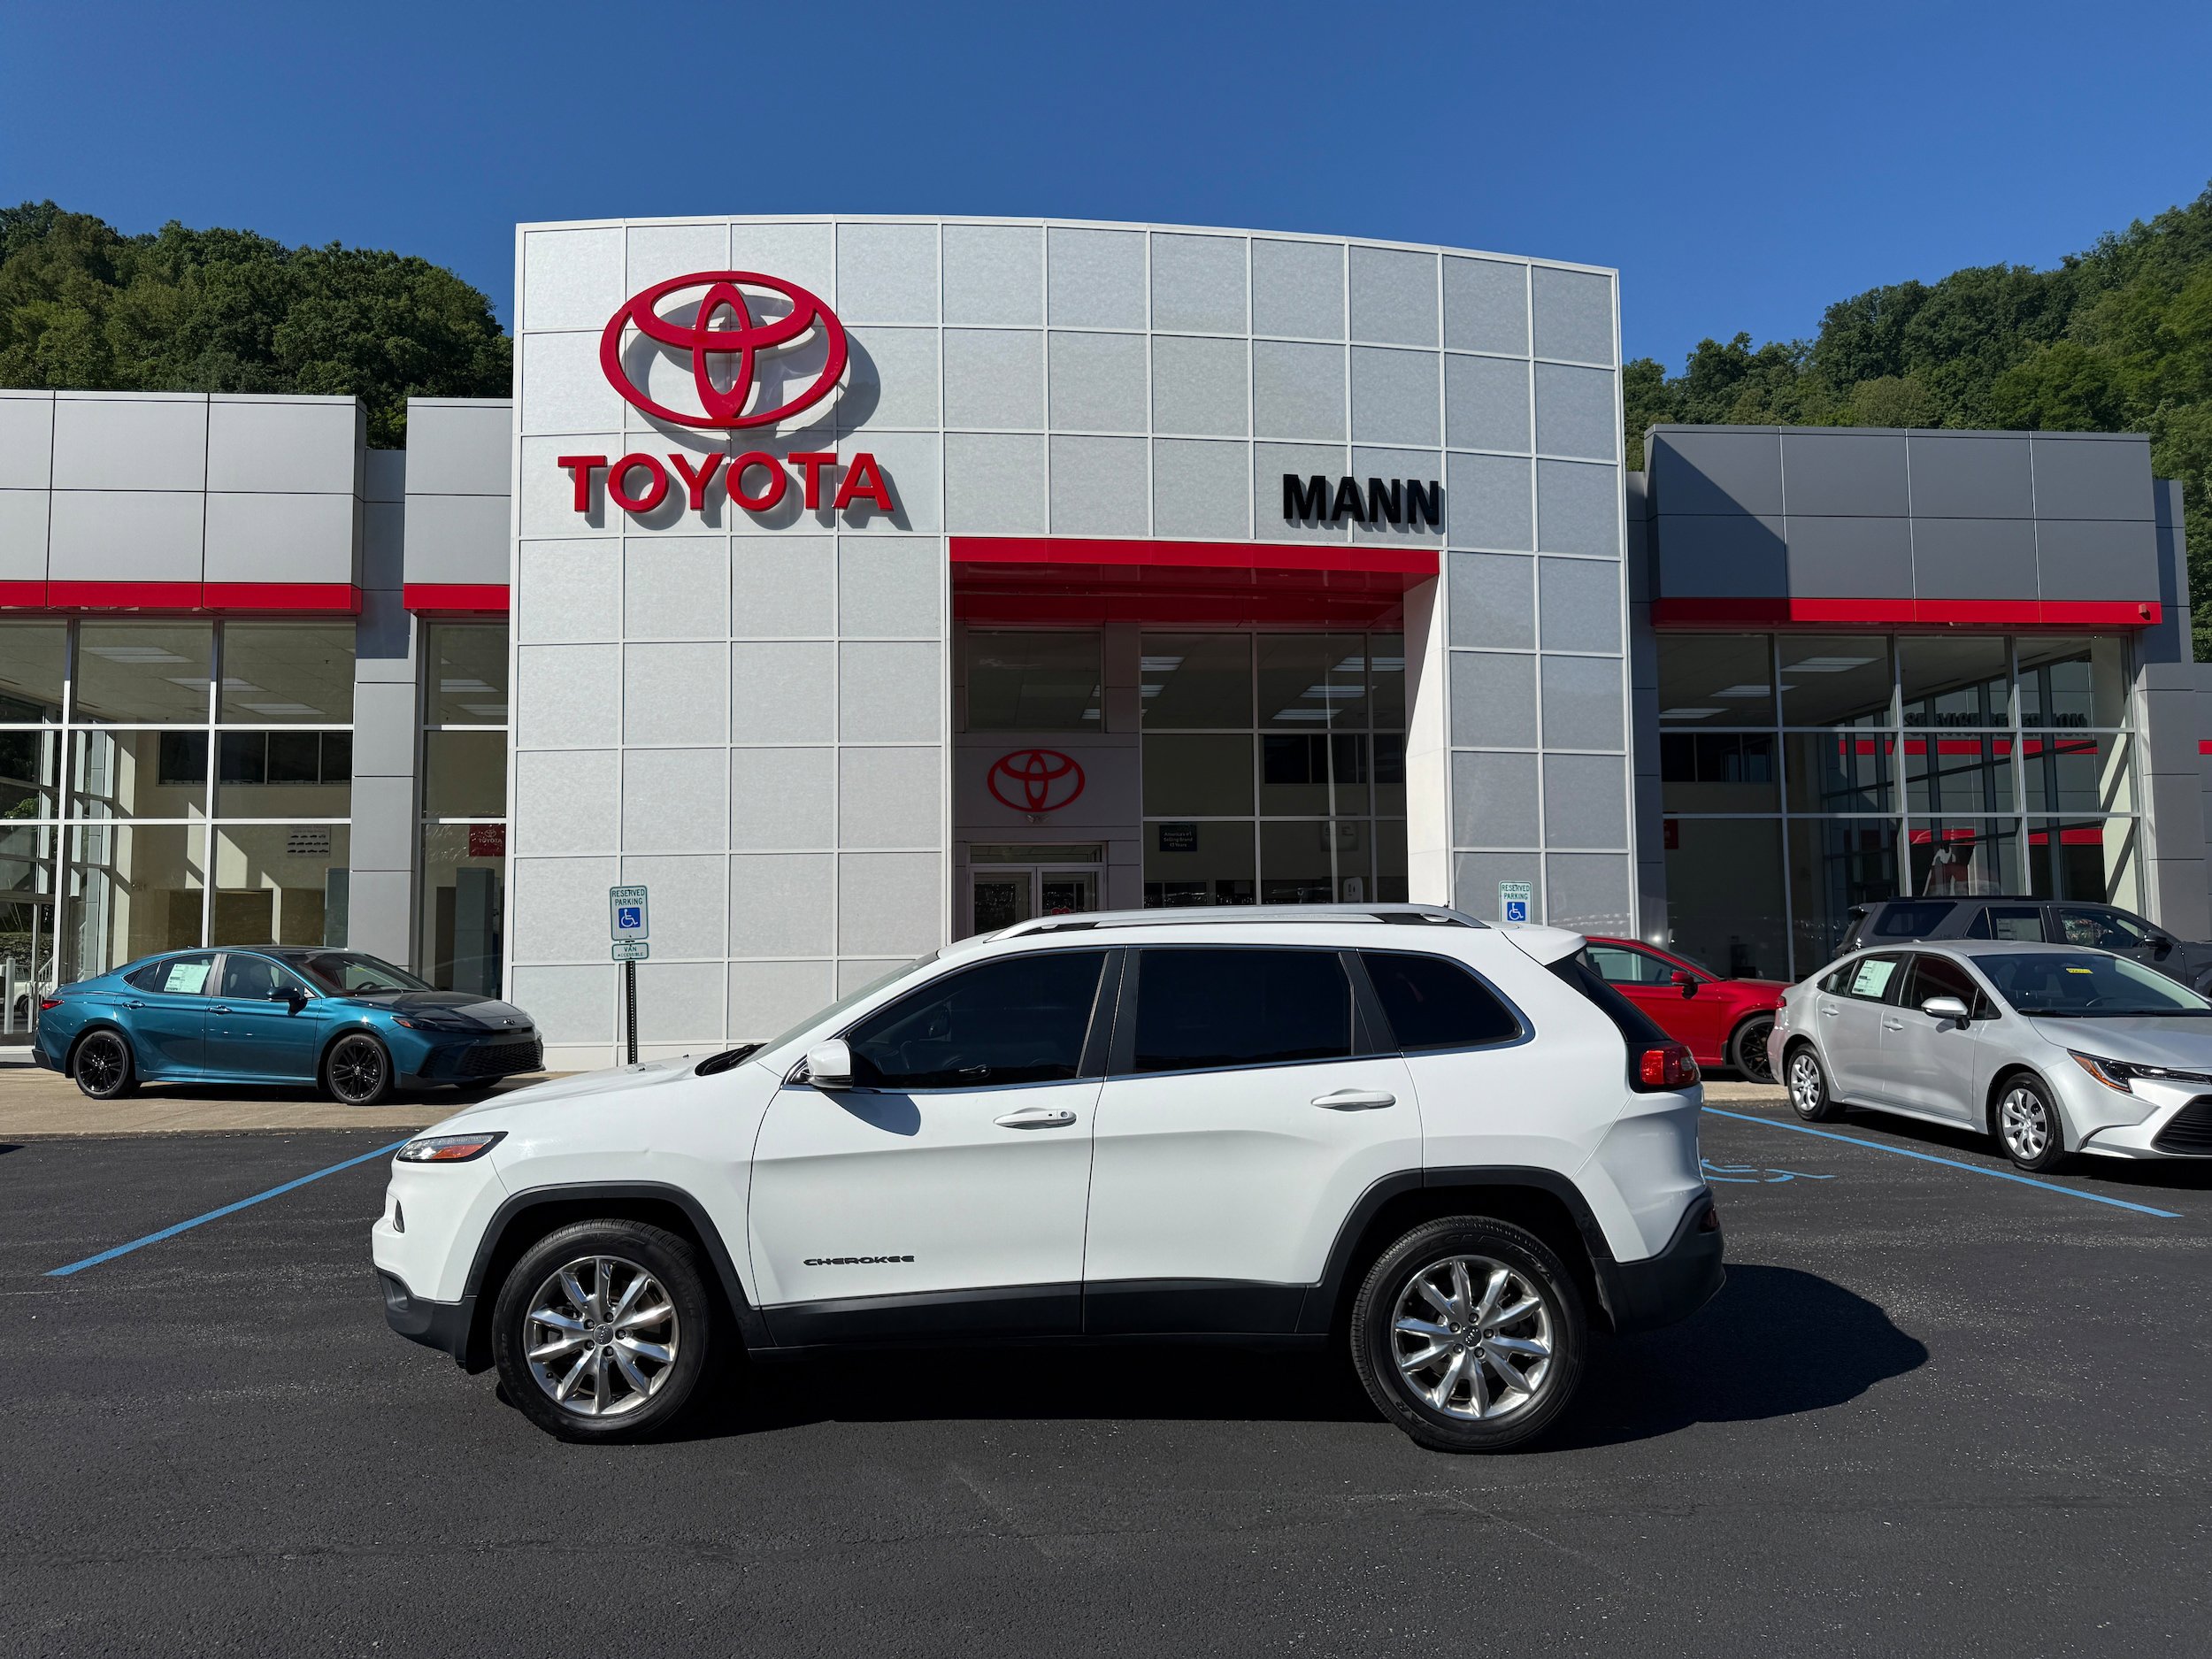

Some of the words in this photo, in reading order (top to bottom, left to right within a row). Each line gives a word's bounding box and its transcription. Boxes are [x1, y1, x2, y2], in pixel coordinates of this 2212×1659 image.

[557, 450, 895, 513] TOYOTA
[1283, 473, 1440, 526] MANN
[1903, 711, 1981, 733] SEVICE
[611, 888, 645, 897] RESERVED
[615, 897, 643, 906] PARKING
[803, 1255, 915, 1266] CHEROKEE
